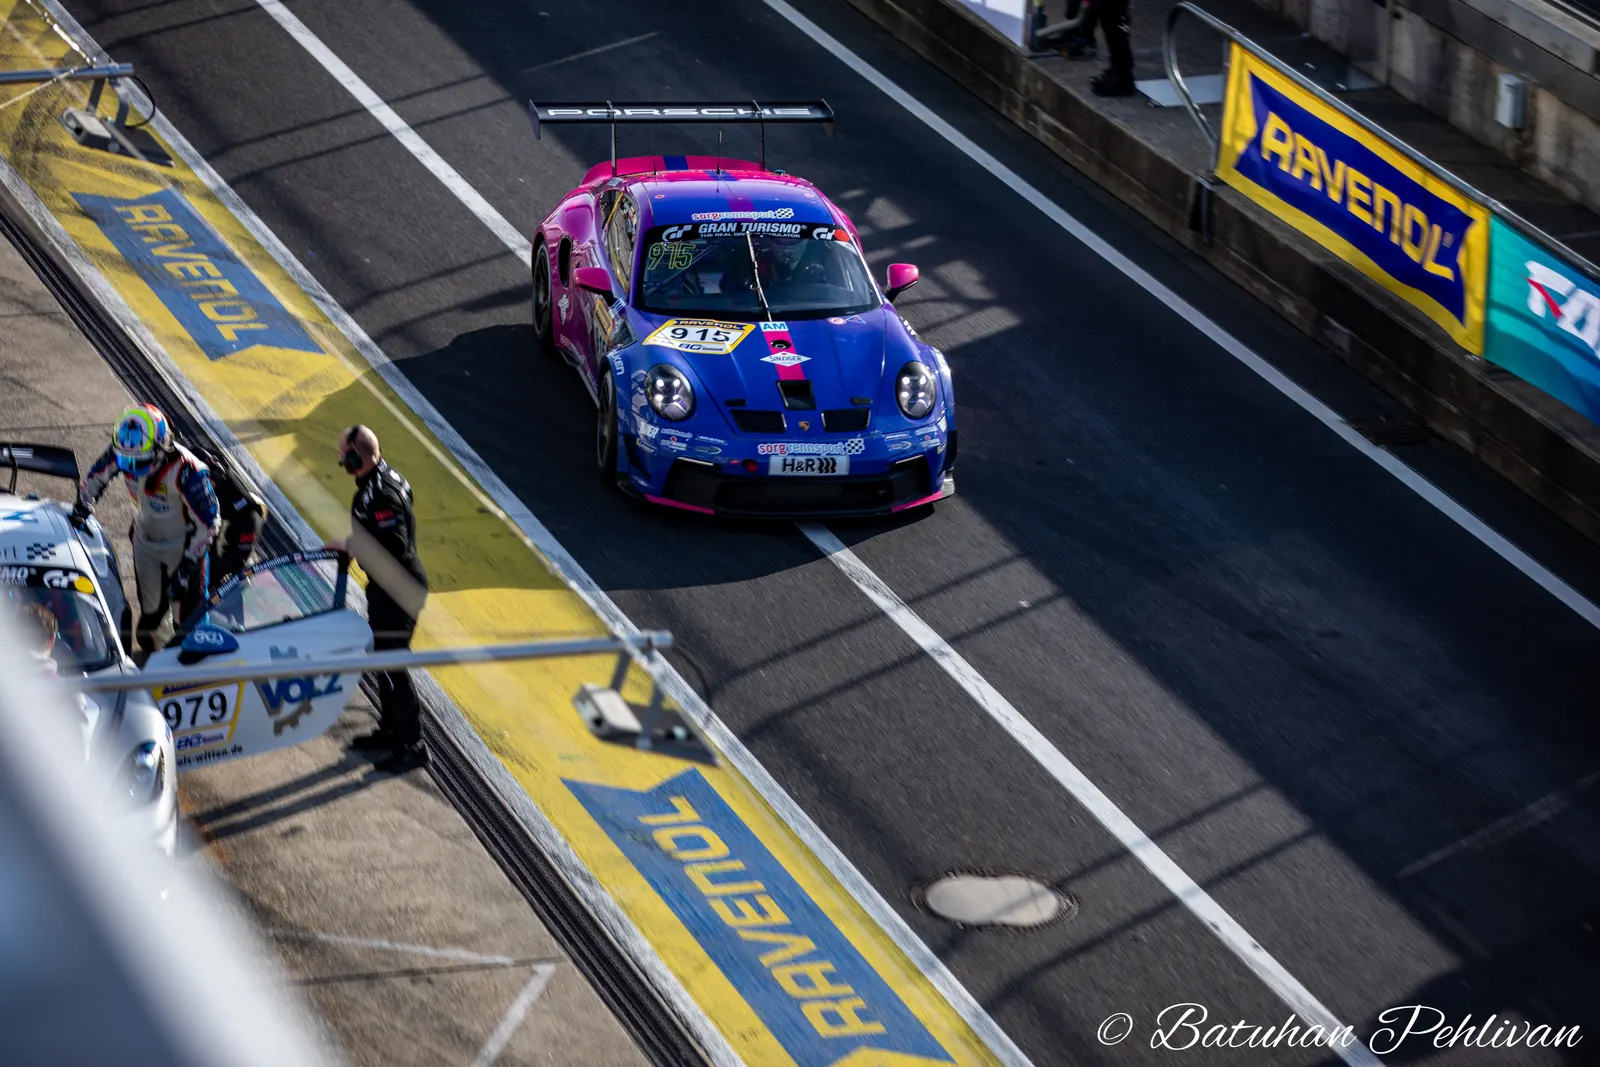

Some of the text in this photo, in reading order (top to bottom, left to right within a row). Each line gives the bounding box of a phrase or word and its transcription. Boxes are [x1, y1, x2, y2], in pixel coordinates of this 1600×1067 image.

[547, 107, 811, 117] PORSCHE
[698, 222, 737, 234] GRAN
[648, 242, 696, 270] 915
[114, 204, 270, 342] RAVENOL
[670, 327, 731, 342] 915
[759, 442, 845, 456] sorgrennsport
[782, 458, 815, 472] H&R
[261, 672, 344, 710] VOLZ
[162, 689, 228, 730] 979
[638, 795, 888, 1039] RAVENOL
